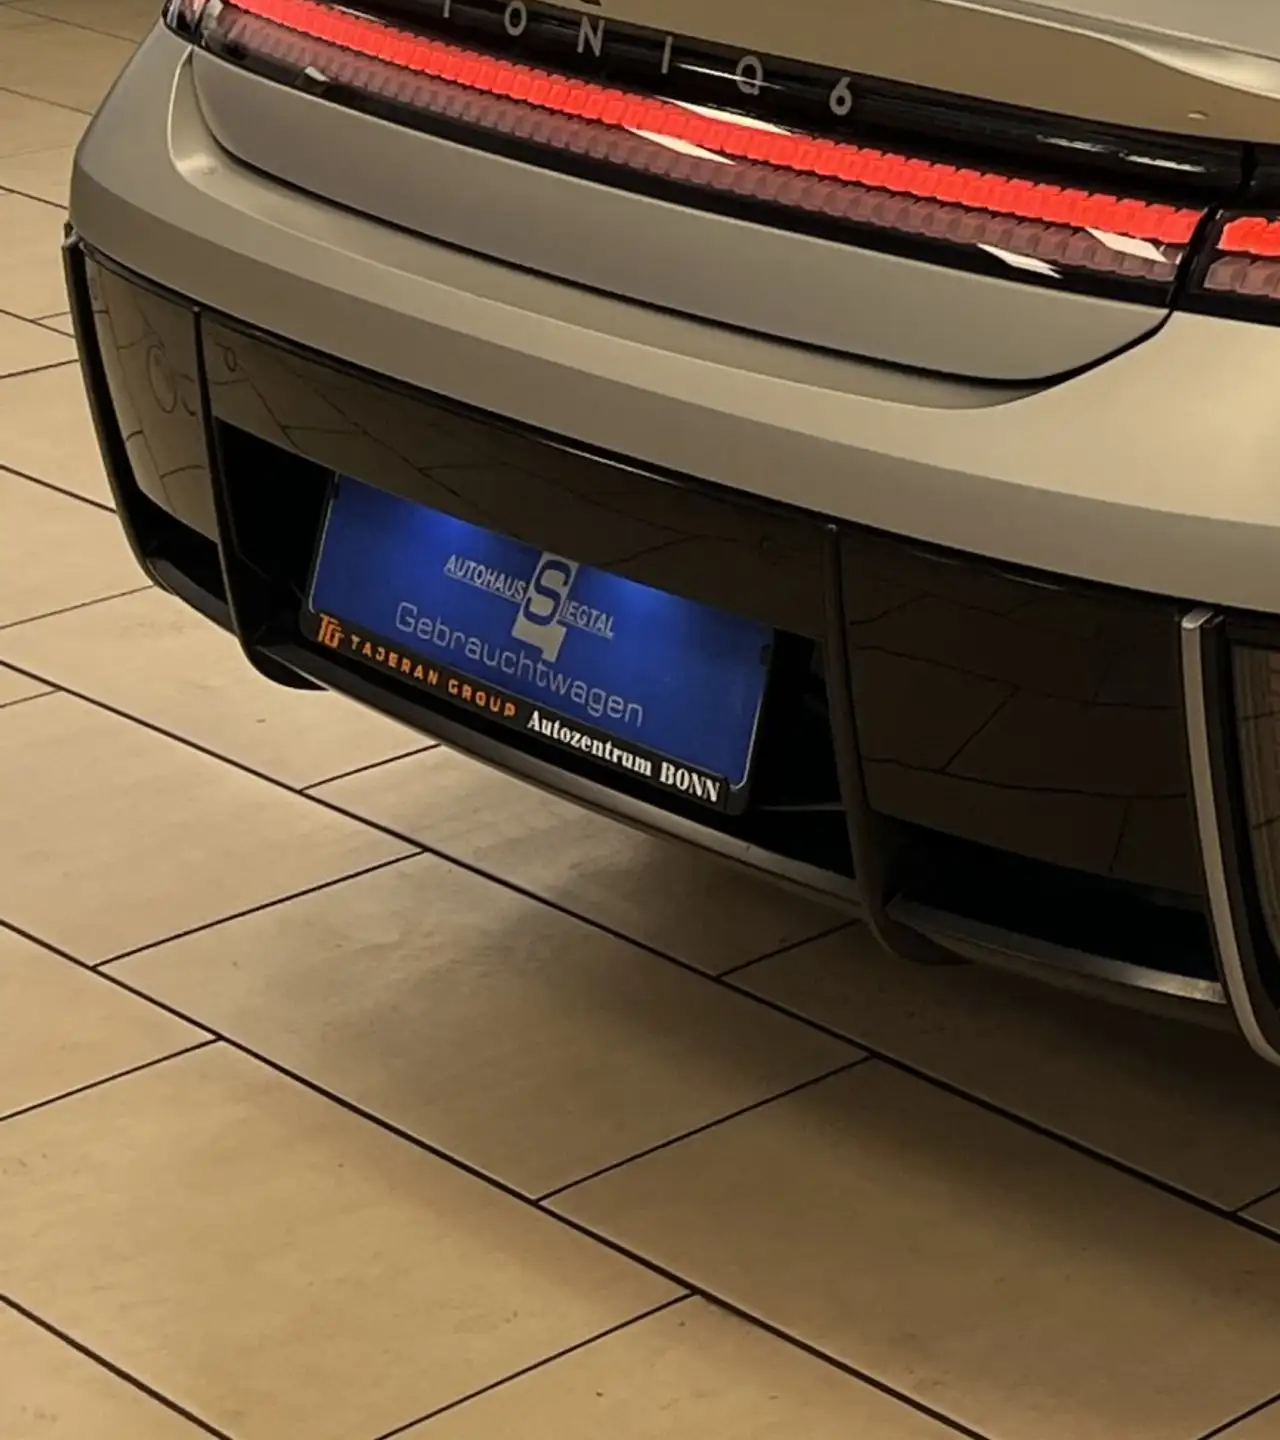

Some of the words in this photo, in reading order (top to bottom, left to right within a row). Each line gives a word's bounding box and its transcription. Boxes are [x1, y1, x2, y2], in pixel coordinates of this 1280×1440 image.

[829, 76, 854, 116] 6
[443, 554, 527, 601] AUTOHAUS
[396, 601, 643, 727] Gebrauchtwagen
[447, 678, 517, 720] GROUP
[527, 709, 653, 777] Autozentrum
[659, 761, 720, 803] BONN
